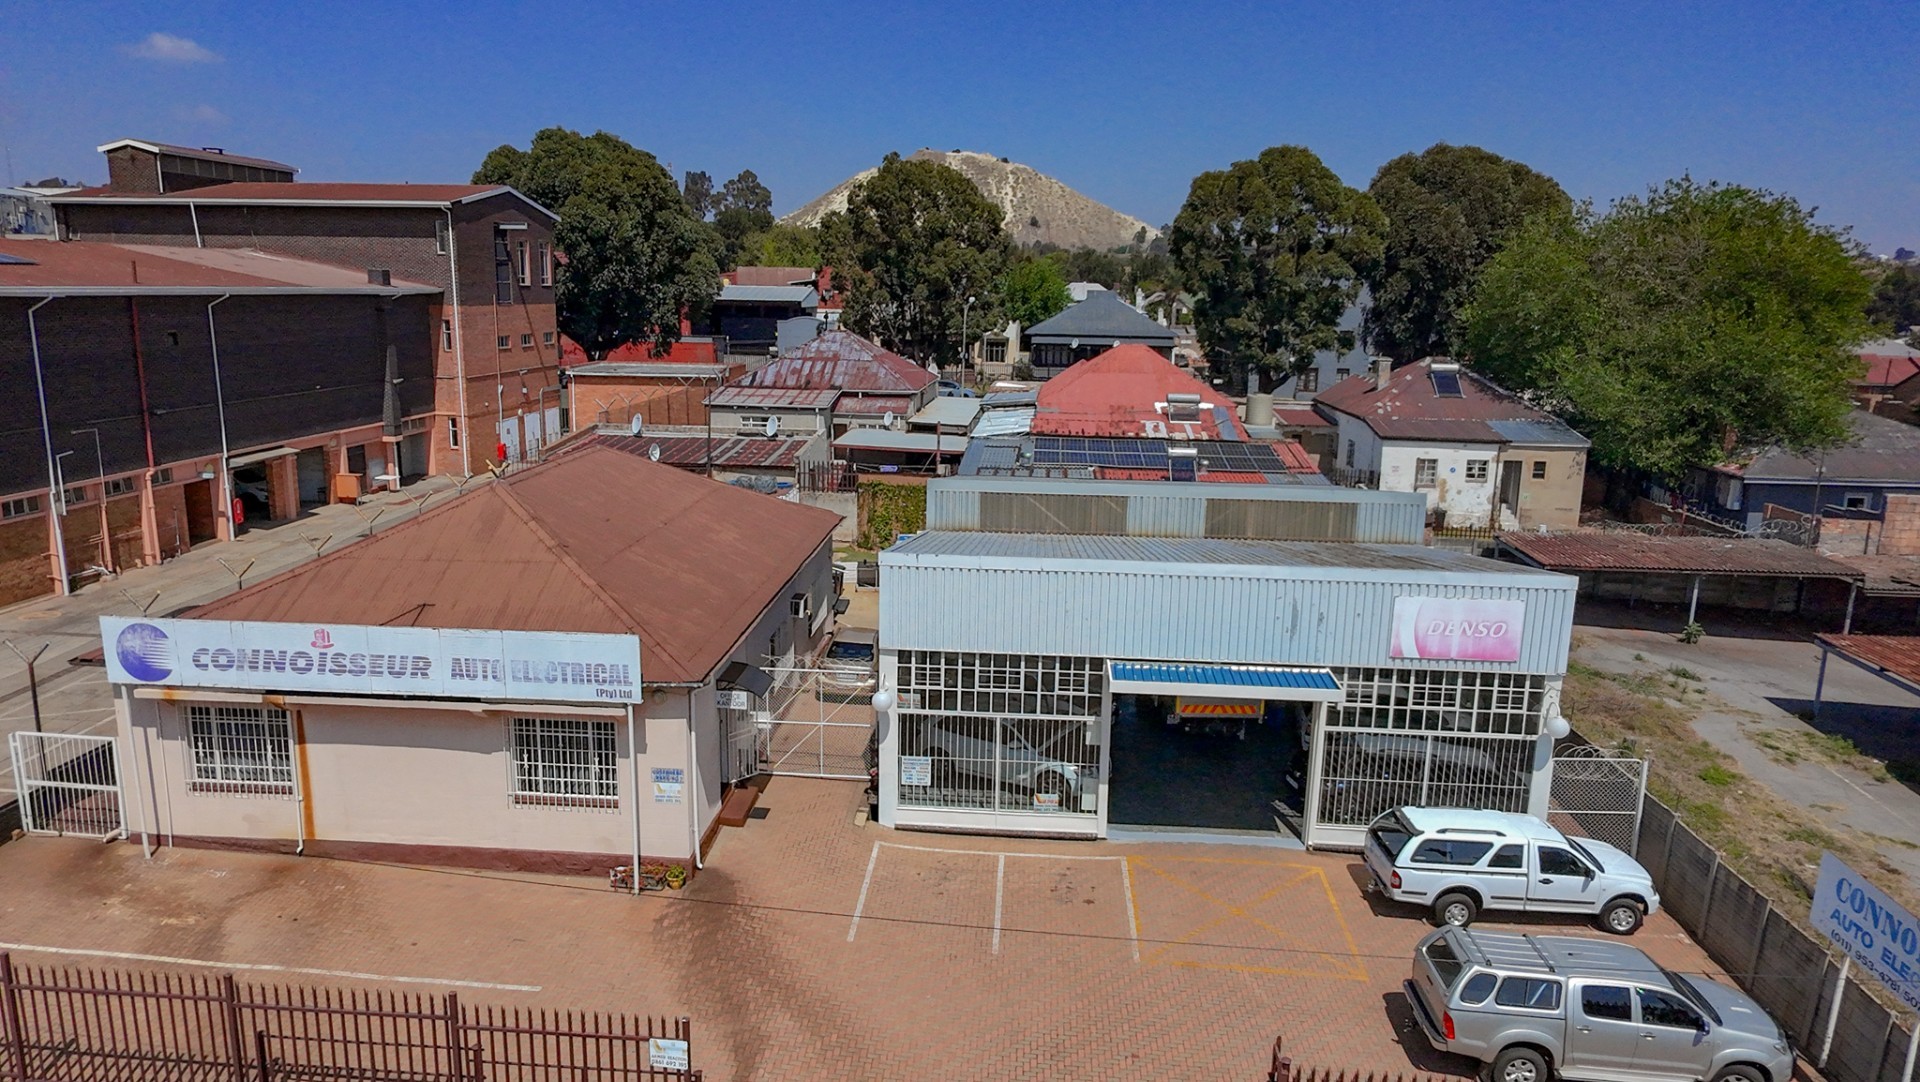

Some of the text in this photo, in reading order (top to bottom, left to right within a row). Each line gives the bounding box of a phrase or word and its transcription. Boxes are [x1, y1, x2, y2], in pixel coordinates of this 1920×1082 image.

[1427, 620, 1508, 638] DENSO
[192, 647, 633, 687] CONNOISSEUR AUTO ELECTRICAL
[596, 688, 632, 699] (Pty) Ltd
[1830, 908, 1874, 949] AUTO
[1831, 929, 1852, 953] (011)
